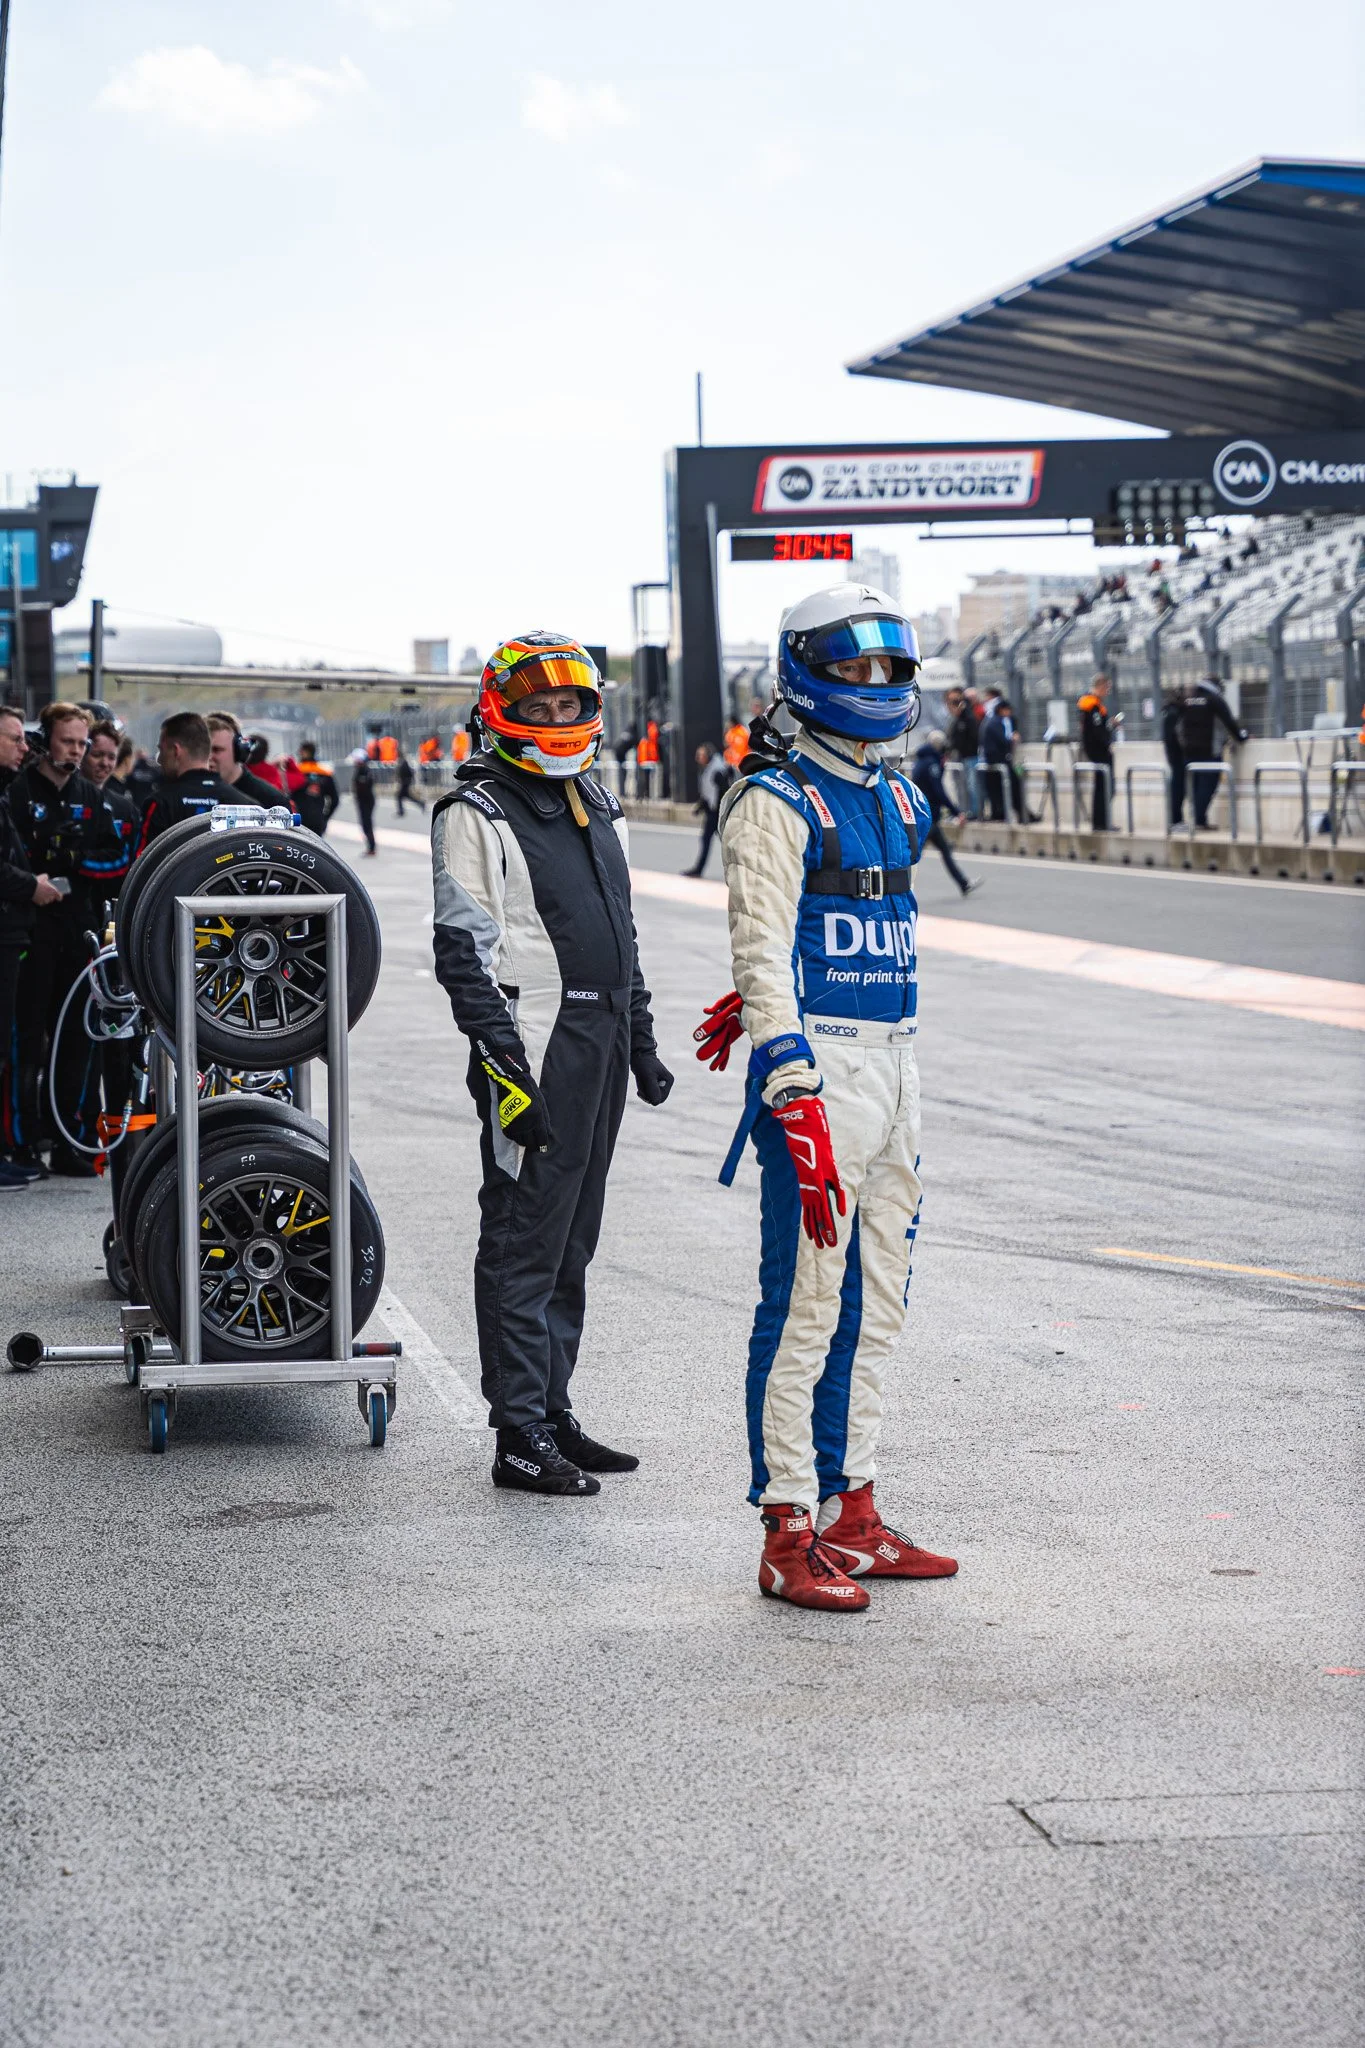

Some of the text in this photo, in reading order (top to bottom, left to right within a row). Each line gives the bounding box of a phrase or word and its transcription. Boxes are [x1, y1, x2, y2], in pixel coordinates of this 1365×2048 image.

[823, 475, 1020, 499] ZANDVOORT
[539, 652, 571, 660] zamp
[787, 686, 815, 710] Duplo
[550, 740, 582, 748] zamp
[759, 775, 801, 801] sparco
[462, 790, 495, 814] sparco
[810, 789, 832, 823] SIMPSON
[894, 785, 913, 821] SIMPSON
[286, 845, 316, 869] 3303
[826, 968, 860, 983] from
[863, 970, 893, 986] print
[567, 990, 599, 1000] sparco
[814, 1022, 858, 1037] sparco
[503, 1097, 522, 1116] OMP
[505, 1453, 541, 1477] sparco
[787, 1518, 809, 1530] OMP
[877, 1543, 900, 1561] OMP
